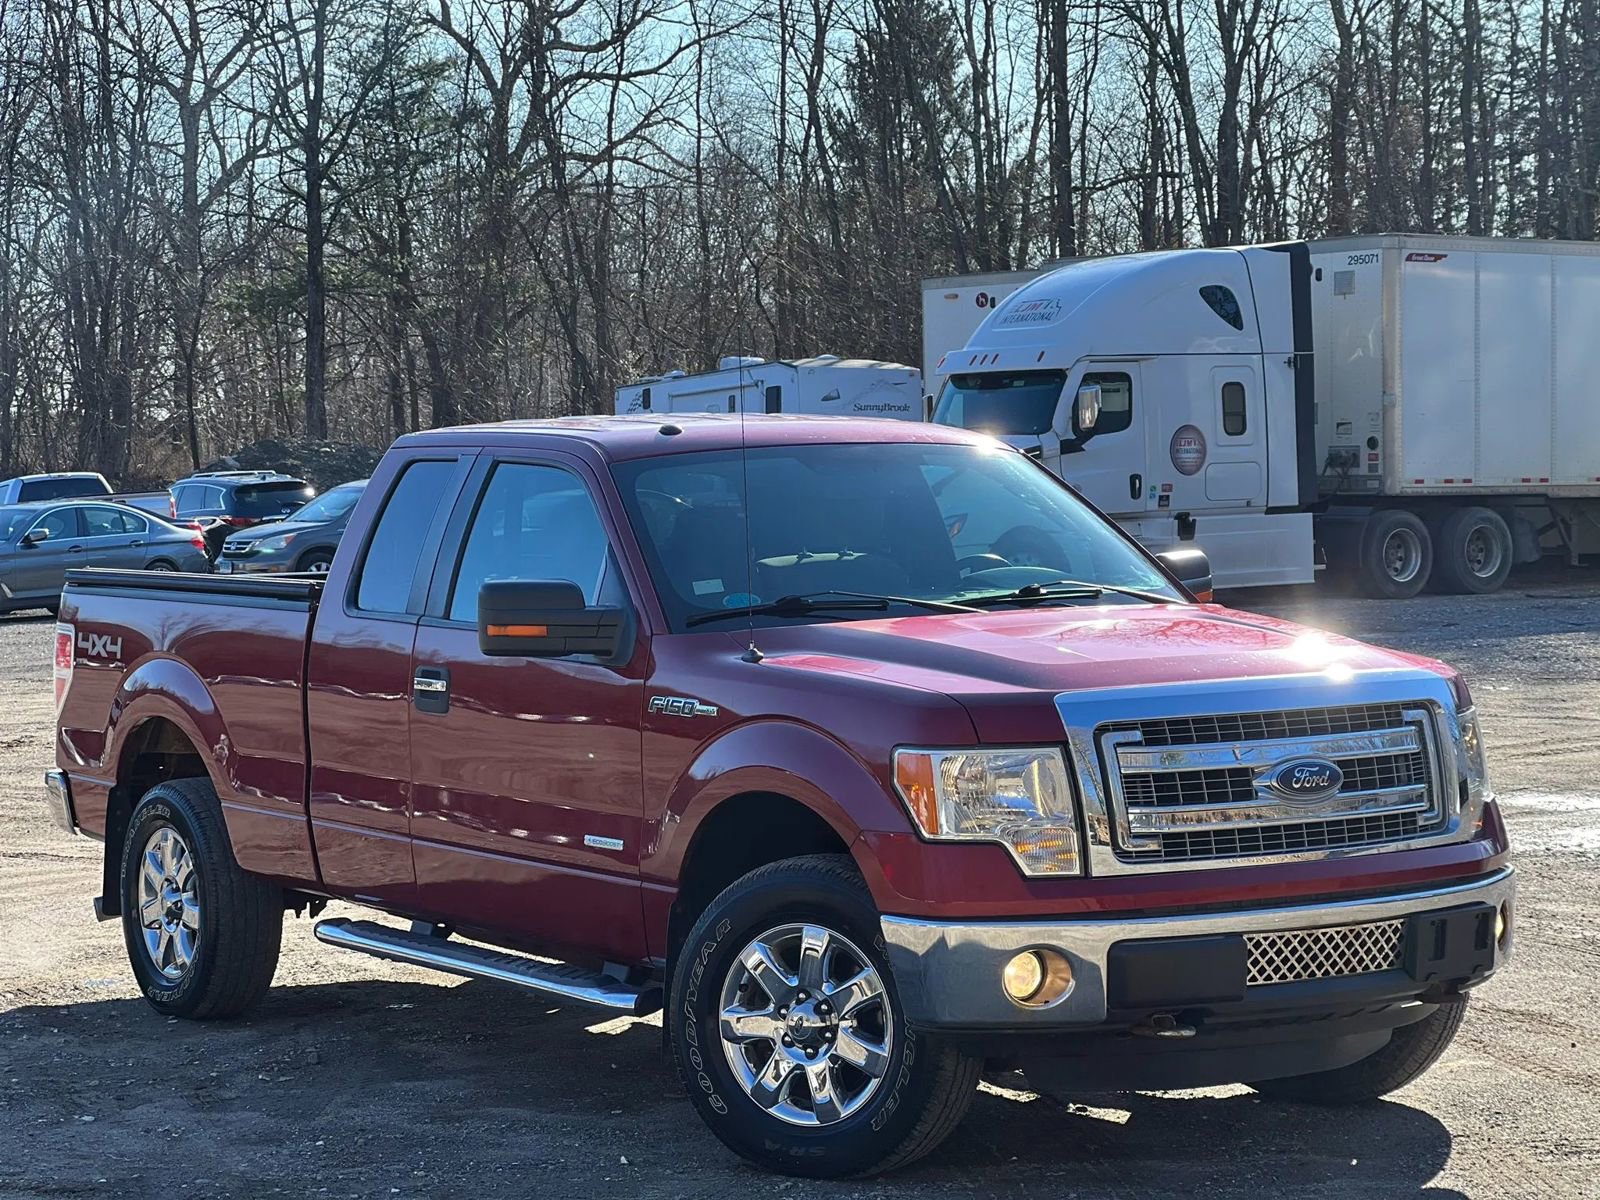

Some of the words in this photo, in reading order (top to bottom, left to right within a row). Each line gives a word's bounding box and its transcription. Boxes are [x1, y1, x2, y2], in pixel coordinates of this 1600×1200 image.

[1347, 253, 1379, 265] 295071
[853, 402, 910, 413] SunnyBrook
[1292, 766, 1330, 788] Ford
[684, 918, 732, 1114] GOODYEAR
